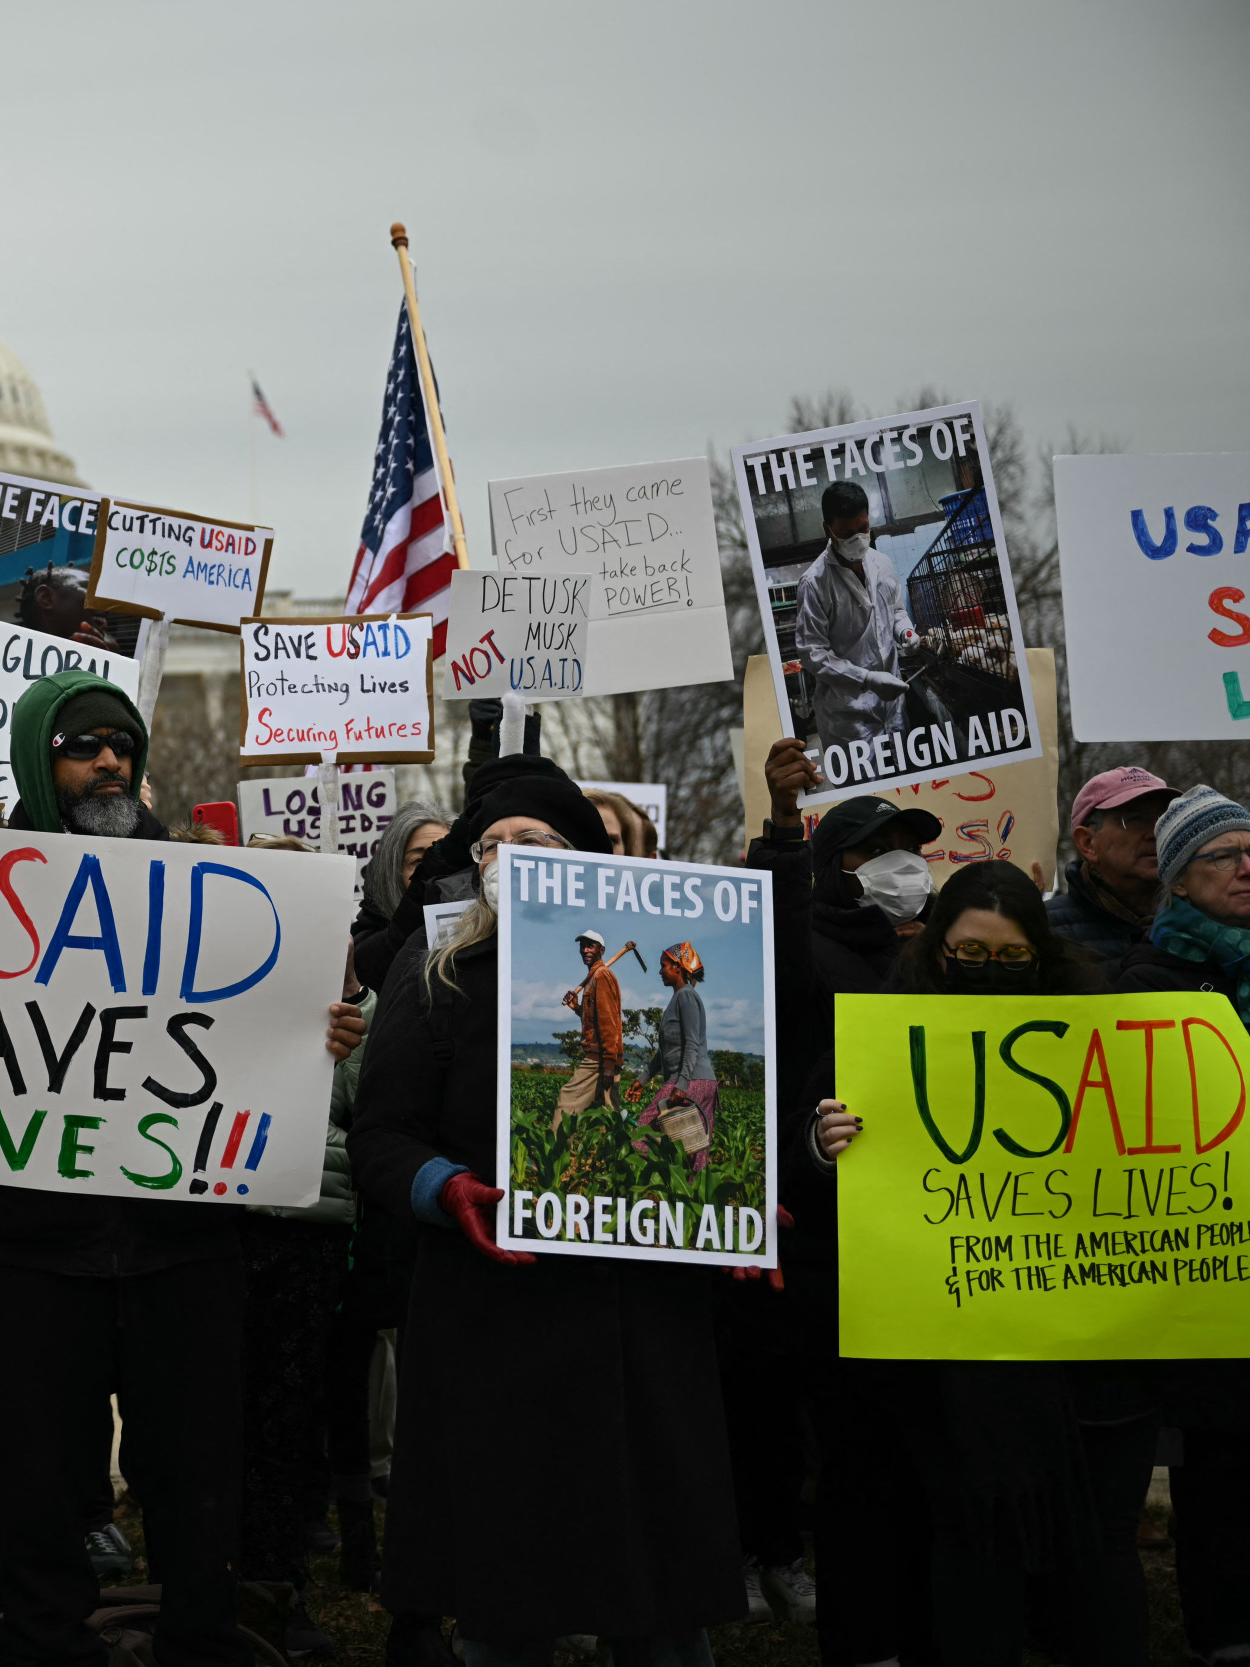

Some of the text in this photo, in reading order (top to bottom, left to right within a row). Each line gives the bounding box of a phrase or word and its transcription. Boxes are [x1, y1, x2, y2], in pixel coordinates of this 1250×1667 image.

[747, 418, 971, 495] THE FACES OF
[25, 491, 98, 536] FACE
[504, 478, 684, 535] First they came
[200, 526, 256, 556] USAID
[504, 539, 543, 570] for
[182, 555, 252, 591] AMERICA
[599, 549, 692, 582] take back
[605, 576, 694, 611] POWER!
[253, 623, 411, 661] SAVE USAID
[525, 622, 578, 654] MUSK
[451, 629, 506, 691] NOT
[360, 673, 409, 694] Lives
[967, 707, 1028, 757] AID
[263, 781, 386, 817] LOSNG
[513, 858, 758, 924] THE FACES OF
[908, 1016, 1246, 1164] USAID
[922, 1151, 1233, 1225] SAVES LIVES!
[513, 1190, 763, 1252] FOREIGN AID
[950, 1221, 1250, 1264] FROM THE AMERICAN PEOPL
[966, 1268, 1004, 1296] FOR
[1010, 1265, 1057, 1292] THE
[1063, 1260, 1168, 1288] AMERICAN
